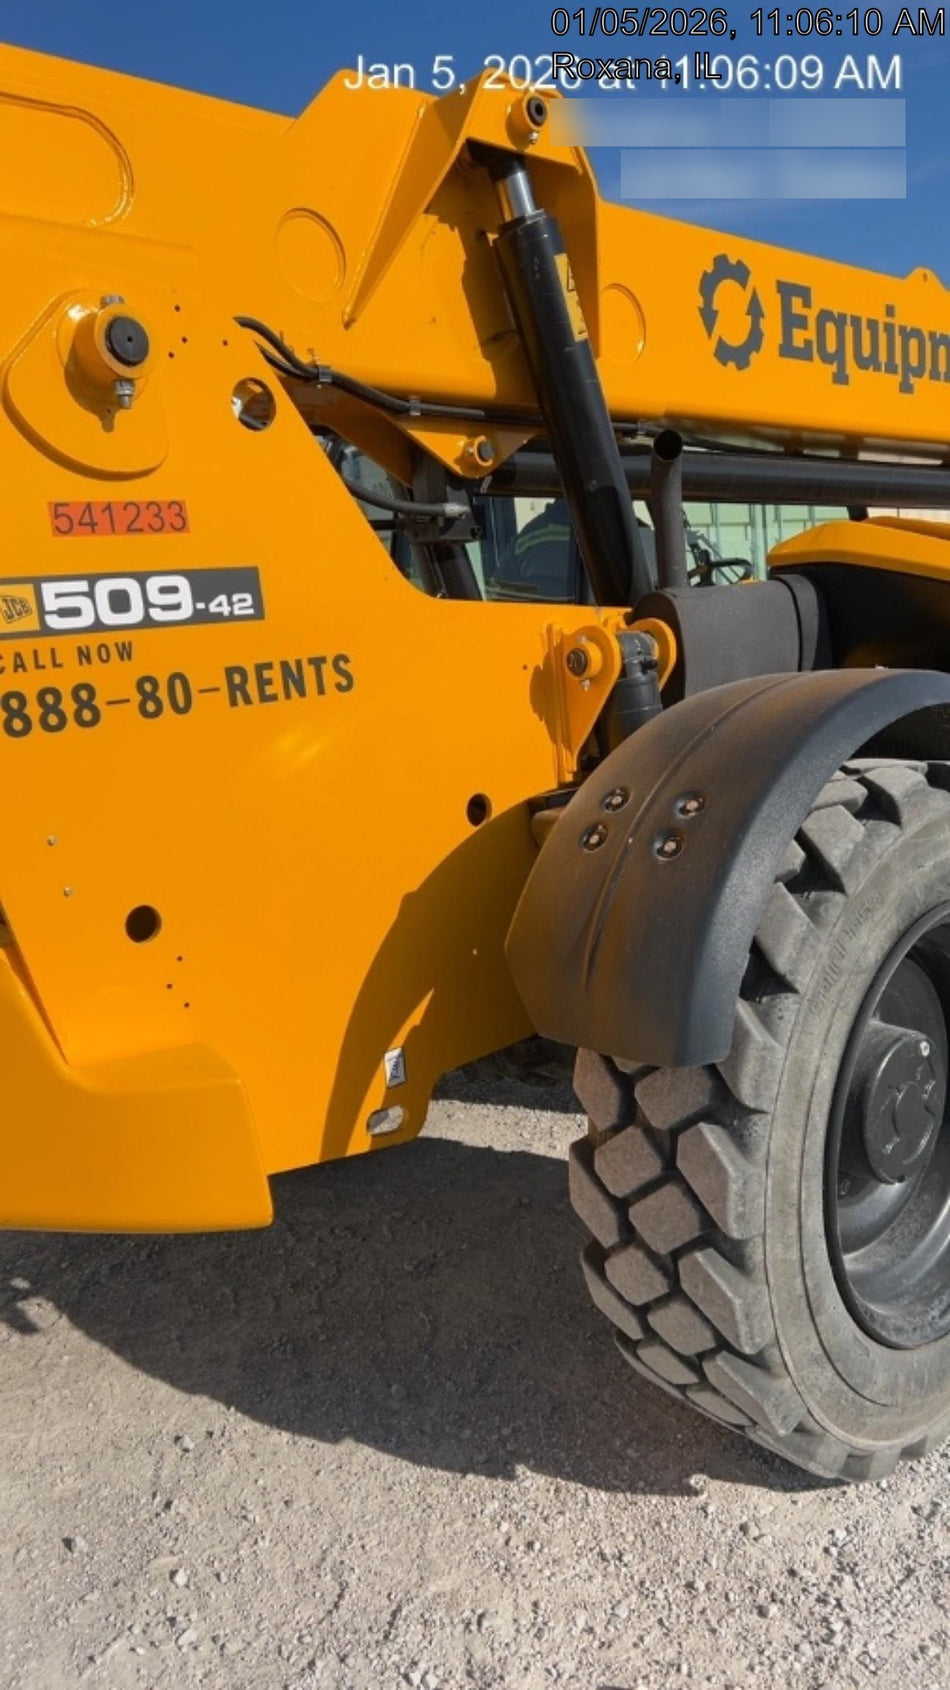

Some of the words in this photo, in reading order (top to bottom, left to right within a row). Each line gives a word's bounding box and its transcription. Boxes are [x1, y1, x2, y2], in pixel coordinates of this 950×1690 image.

[53, 501, 187, 535] 541233
[2, 596, 32, 623] JCB
[77, 641, 134, 667] NOW
